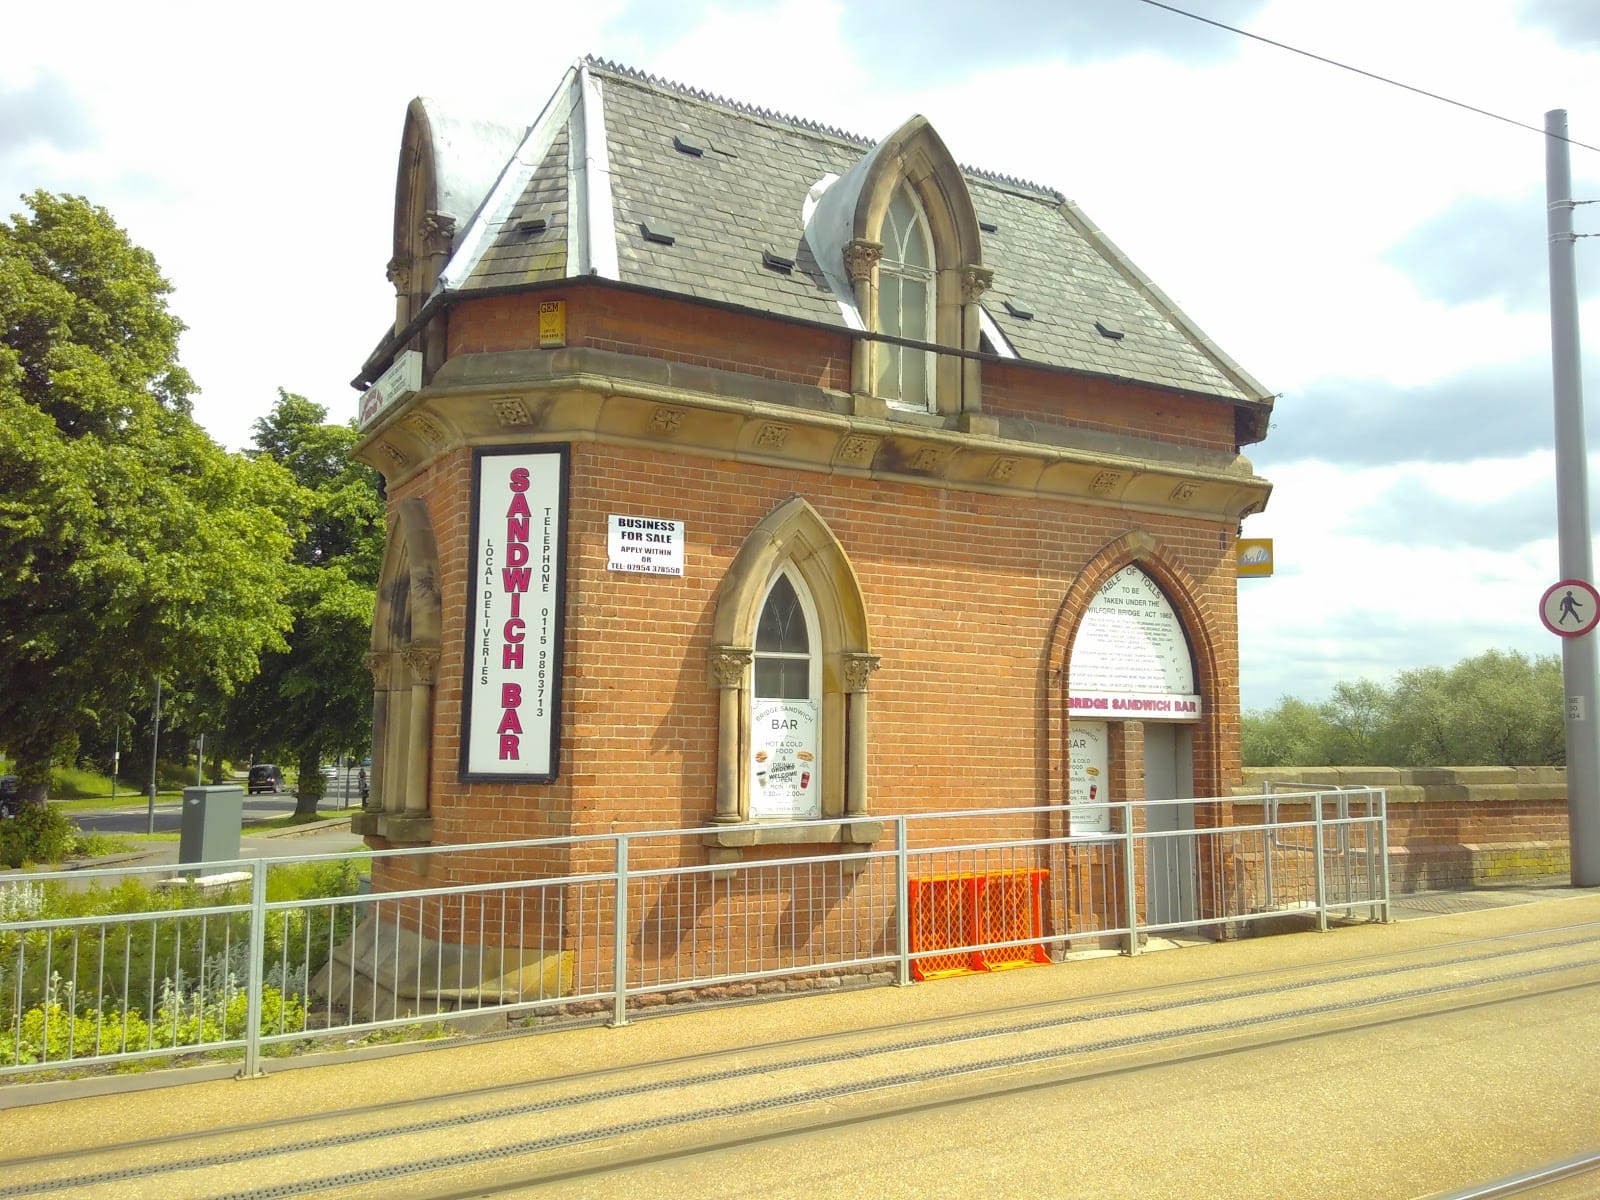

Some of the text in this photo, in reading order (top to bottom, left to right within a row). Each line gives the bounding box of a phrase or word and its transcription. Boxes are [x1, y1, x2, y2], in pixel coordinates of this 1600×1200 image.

[541, 302, 559, 313] GEM
[618, 518, 675, 532] BUSINESS
[621, 531, 672, 543] FOR SALE
[644, 548, 672, 556] WITHIN
[611, 562, 626, 570] TEL:
[1100, 567, 1161, 599] TABLE OF TOLLS
[1121, 586, 1140, 595] TO BE
[1104, 597, 1160, 608] TAKEN UNDER THE
[481, 538, 494, 685] LOCAL DELIVERIES
[497, 467, 532, 760] SANDWICH BAR
[536, 507, 552, 717] TELEPHONE 0115 9863713
[1087, 606, 1116, 615] WILFORD
[1117, 608, 1141, 617] BRIDGE
[1144, 610, 1157, 618] ACT
[1068, 697, 1196, 712] BRIDGE SANDWICH BAR
[756, 705, 813, 723] BRIDGE SANDWICH
[771, 719, 798, 730] BAR
